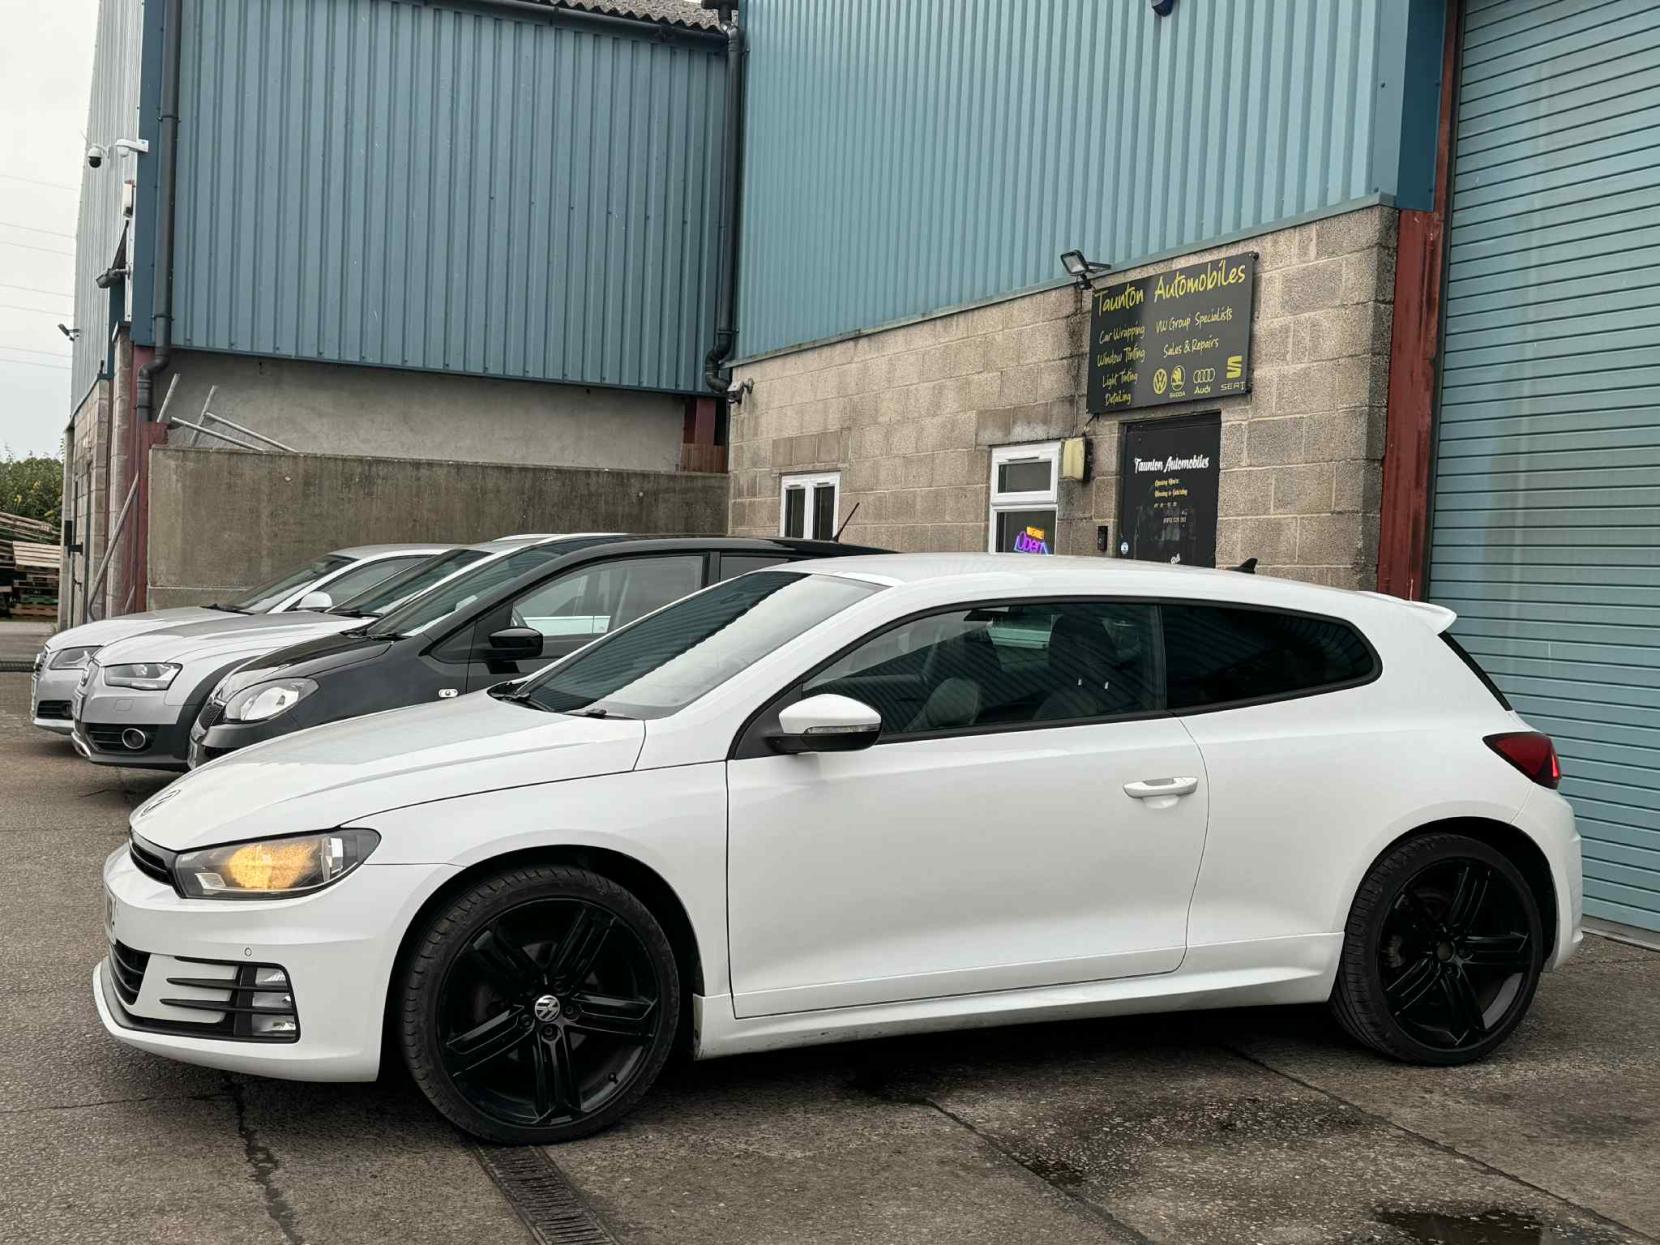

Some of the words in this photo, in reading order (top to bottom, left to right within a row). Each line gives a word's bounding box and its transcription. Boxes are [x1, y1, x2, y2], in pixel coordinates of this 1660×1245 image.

[1095, 283, 1144, 316] Taunton
[1154, 259, 1246, 303] Automobiles
[1168, 316, 1191, 331] Group
[1195, 305, 1233, 329] Specialists
[1099, 330, 1112, 344] Car
[1113, 321, 1145, 342] Wrapping
[1097, 348, 1122, 367] Window
[1123, 344, 1145, 363] Tinting
[1163, 342, 1182, 358] Sales
[1183, 340, 1191, 353] &
[1191, 334, 1219, 355] Repairs
[1102, 373, 1117, 389] Light
[1119, 368, 1138, 384] Tinting
[1220, 381, 1246, 391] SEAT
[1104, 390, 1131, 406] Detailing
[1194, 386, 1211, 394] Audi
[1134, 457, 1163, 474] Taunton
[1163, 453, 1209, 473] Automobiles
